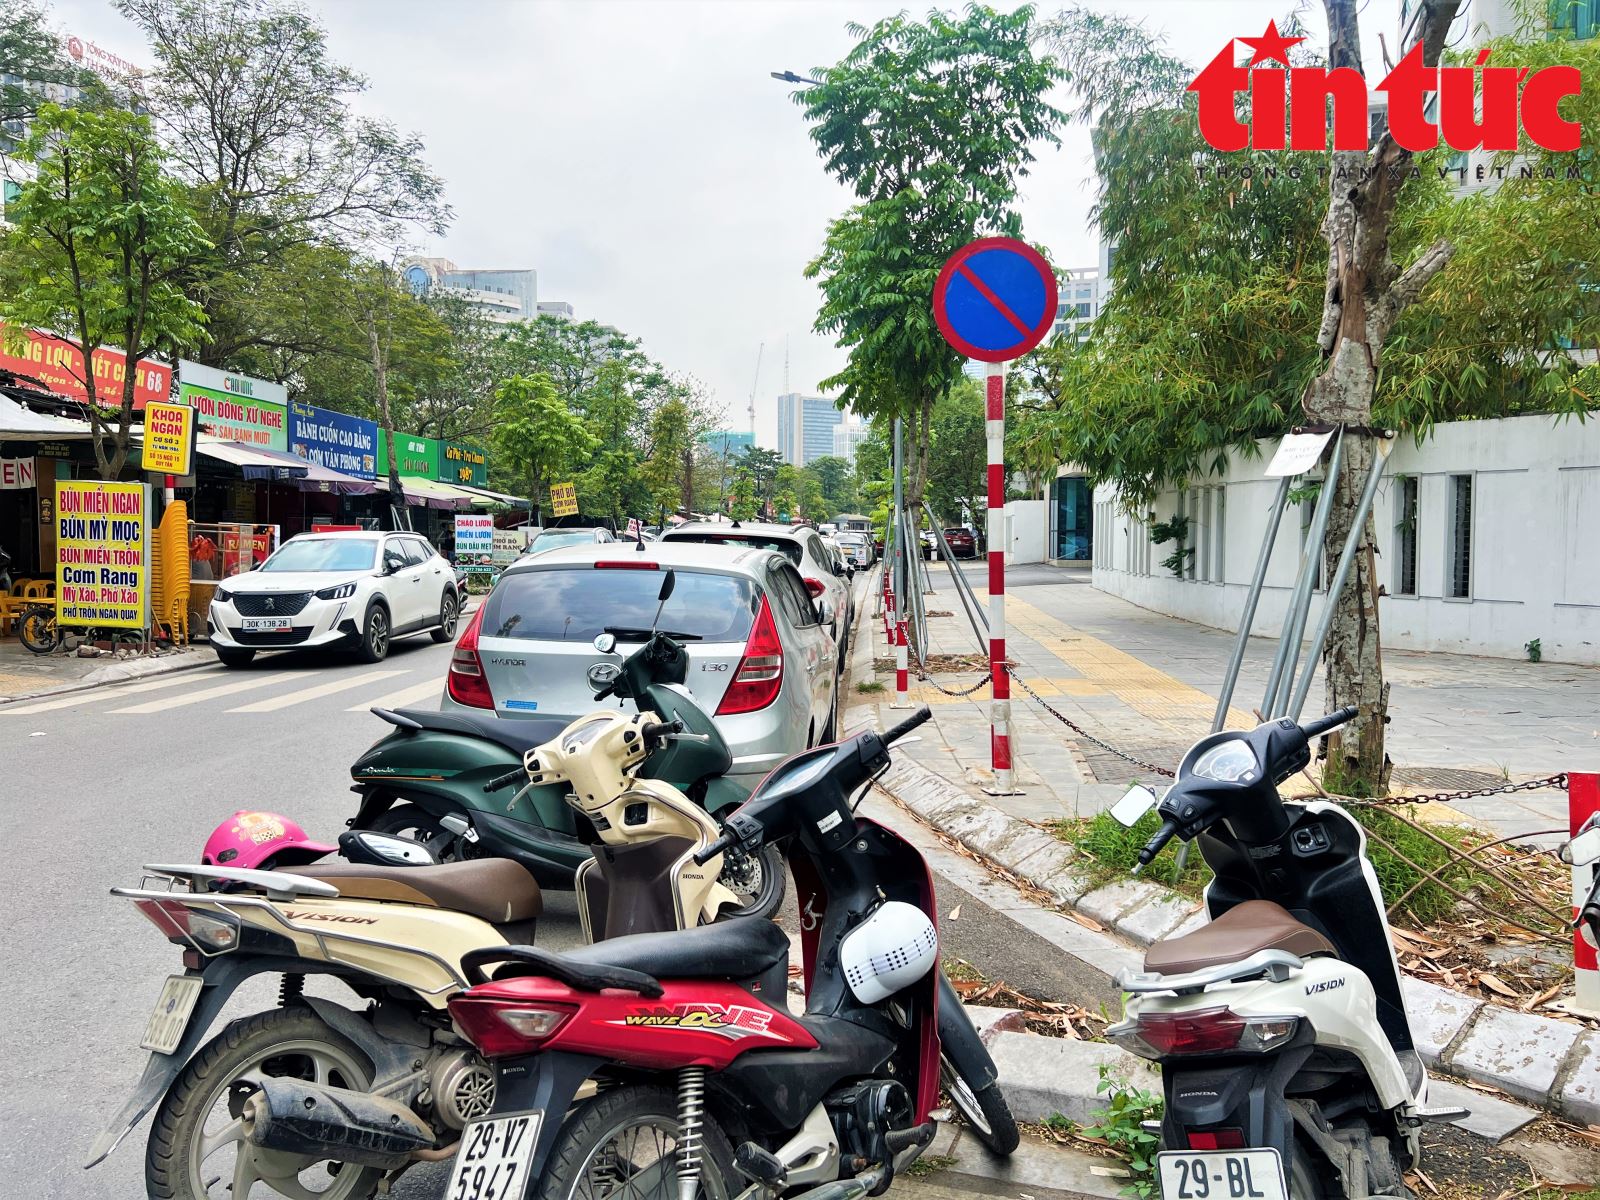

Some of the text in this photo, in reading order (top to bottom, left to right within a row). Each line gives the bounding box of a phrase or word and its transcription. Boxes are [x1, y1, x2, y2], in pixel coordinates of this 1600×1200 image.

[39, 371, 66, 384] Ngon
[147, 370, 163, 393] 68
[152, 408, 183, 423] KHOA
[151, 421, 182, 437] NGAN
[318, 420, 338, 444] CUỐN
[339, 429, 353, 448] CAO
[112, 492, 140, 514] NGAN
[60, 514, 140, 546] BÚN MỲ MỌC
[60, 545, 140, 568] BÚN MIẾN TRỘN
[63, 566, 138, 587] Cơm Rang
[101, 586, 118, 603] Phở
[99, 608, 119, 620] NGAN
[120, 609, 138, 621] QUAY
[491, 657, 527, 666] HYUNDAI
[701, 661, 729, 672] i30
[283, 910, 380, 926] VISION
[1305, 977, 1345, 996] VISION
[1180, 1090, 1219, 1098] HONDA
[1174, 1156, 1265, 1199] 29-BL
